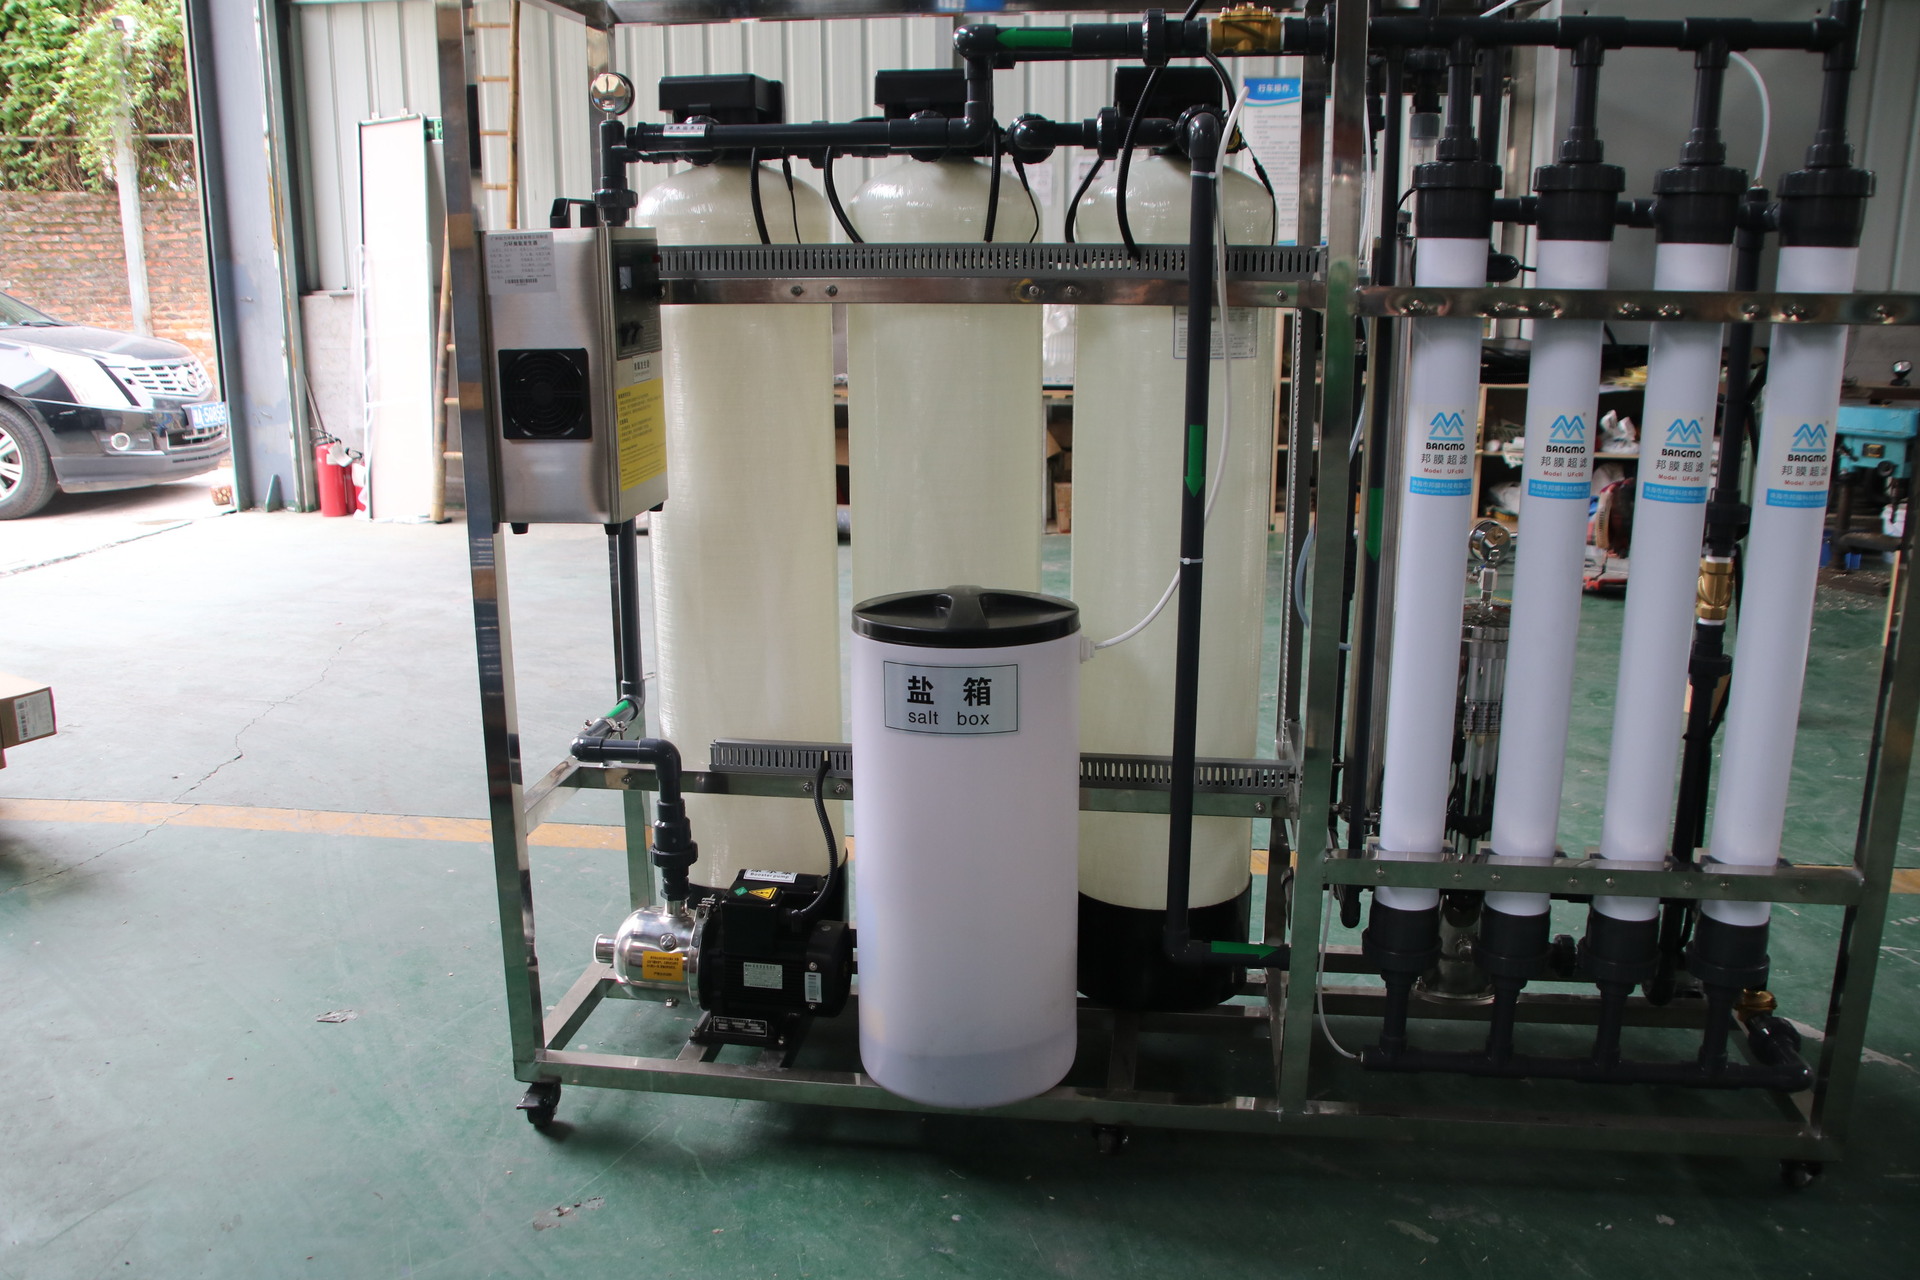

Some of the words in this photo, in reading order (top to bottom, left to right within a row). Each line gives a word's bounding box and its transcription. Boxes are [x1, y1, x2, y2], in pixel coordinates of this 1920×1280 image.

[1426, 442, 1465, 451] BANGMO
[1546, 445, 1586, 454] BANGMO
[1661, 448, 1702, 458] BANGMO
[1787, 454, 1827, 462] BANGMO
[1421, 453, 1468, 465] 邦膜超滤
[907, 676, 992, 706] 盐箱
[908, 710, 939, 724] salt
[957, 711, 990, 726] box
